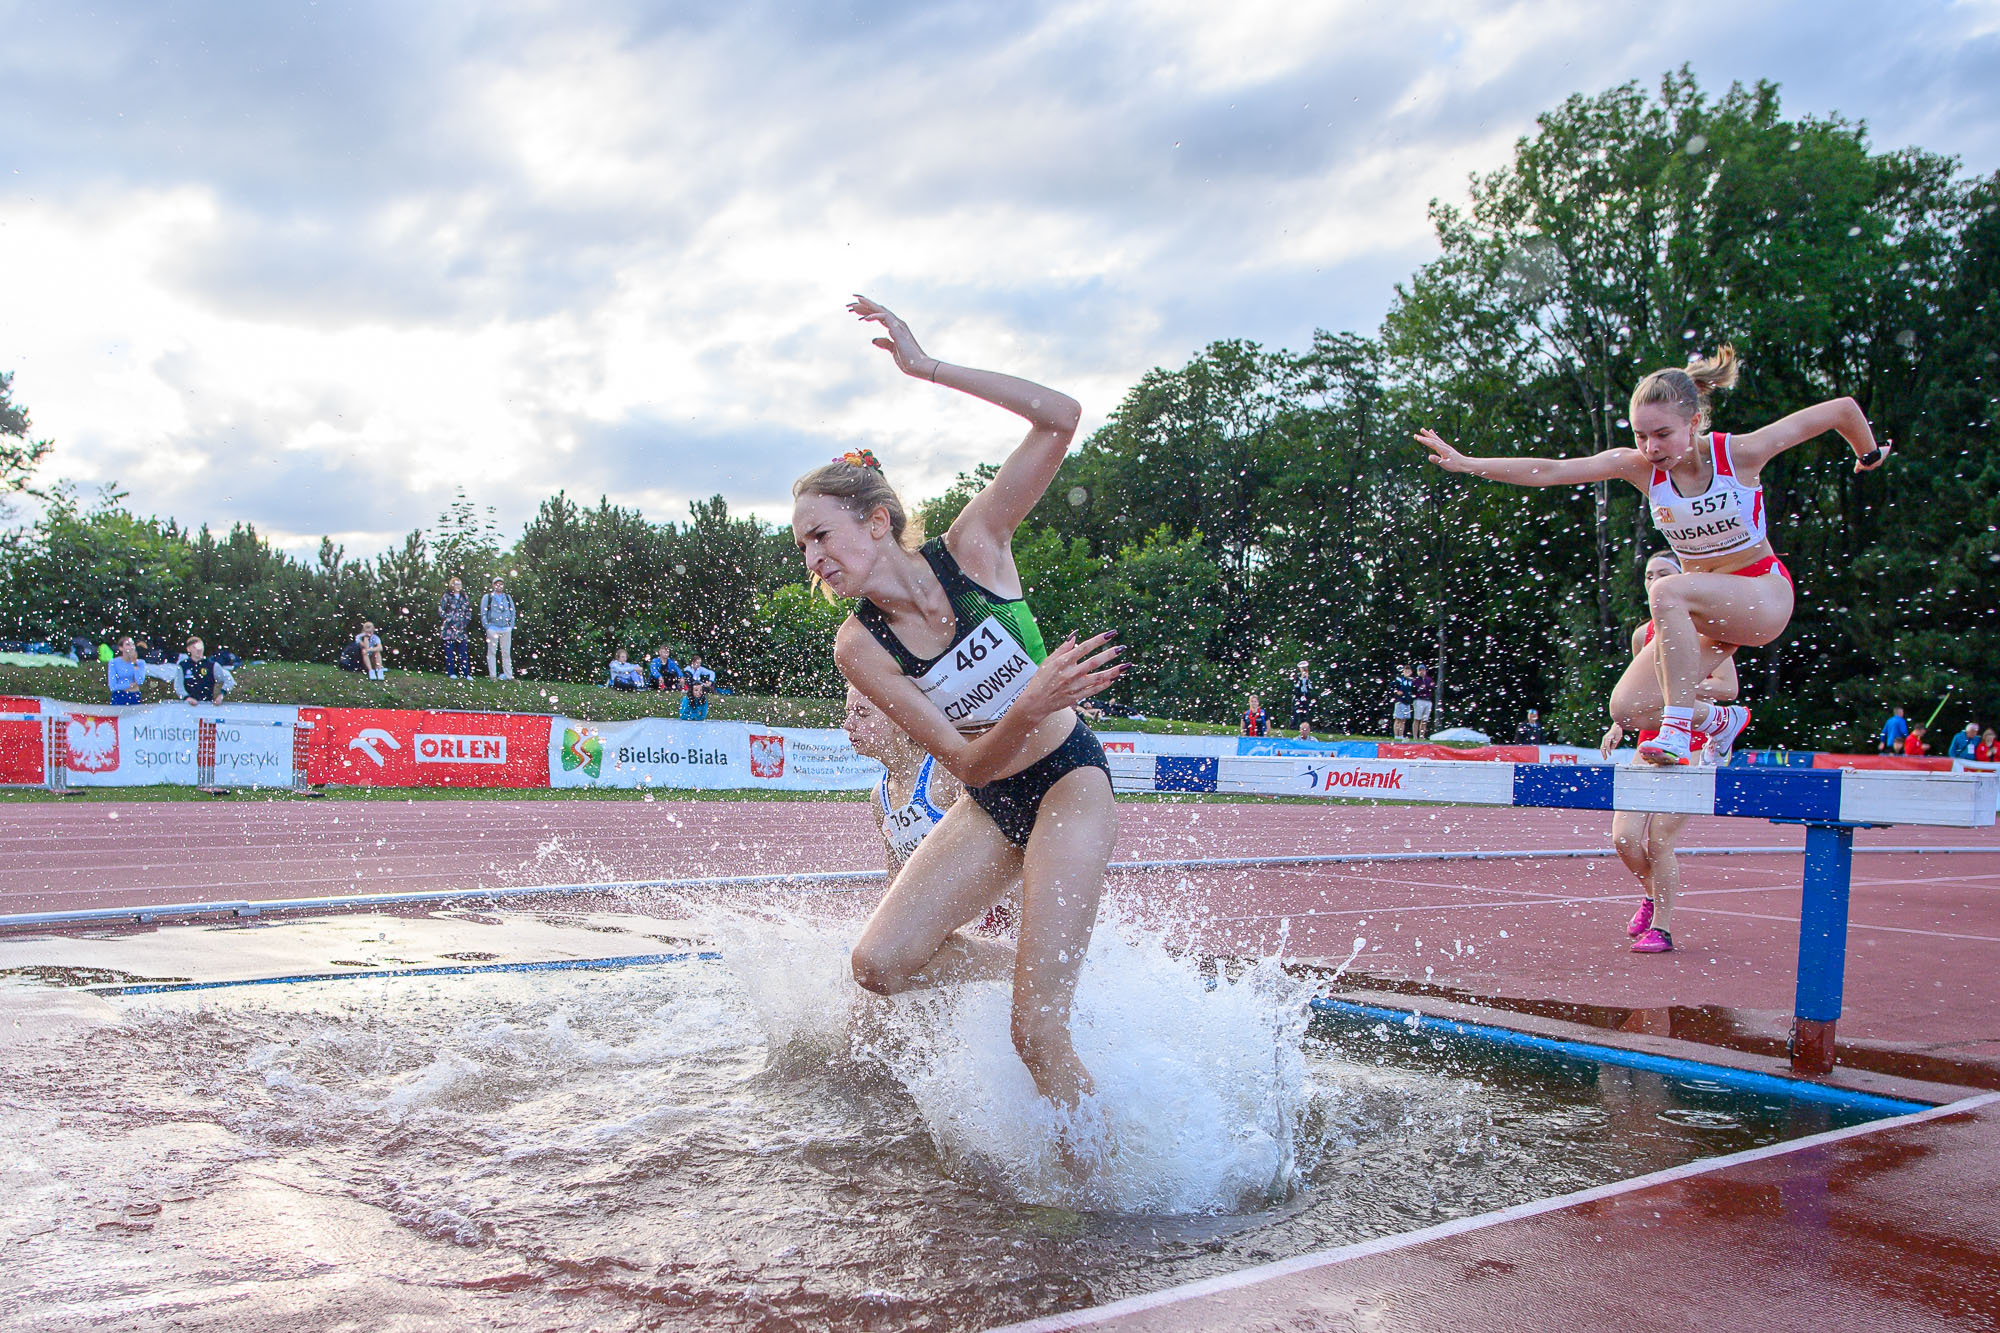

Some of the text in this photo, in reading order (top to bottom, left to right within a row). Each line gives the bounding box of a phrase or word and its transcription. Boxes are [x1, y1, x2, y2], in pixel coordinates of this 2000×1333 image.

[1691, 492, 1728, 517] 557
[955, 626, 1004, 672] 461
[944, 654, 1029, 722] CZANOWSKA
[133, 725, 240, 743] Ministerwo
[135, 750, 279, 769] Sportu urystyki
[420, 738, 500, 759] ORLEN
[619, 746, 728, 766] Bielsko-Biała
[1324, 761, 1403, 792] polanik
[890, 805, 922, 831] 761
